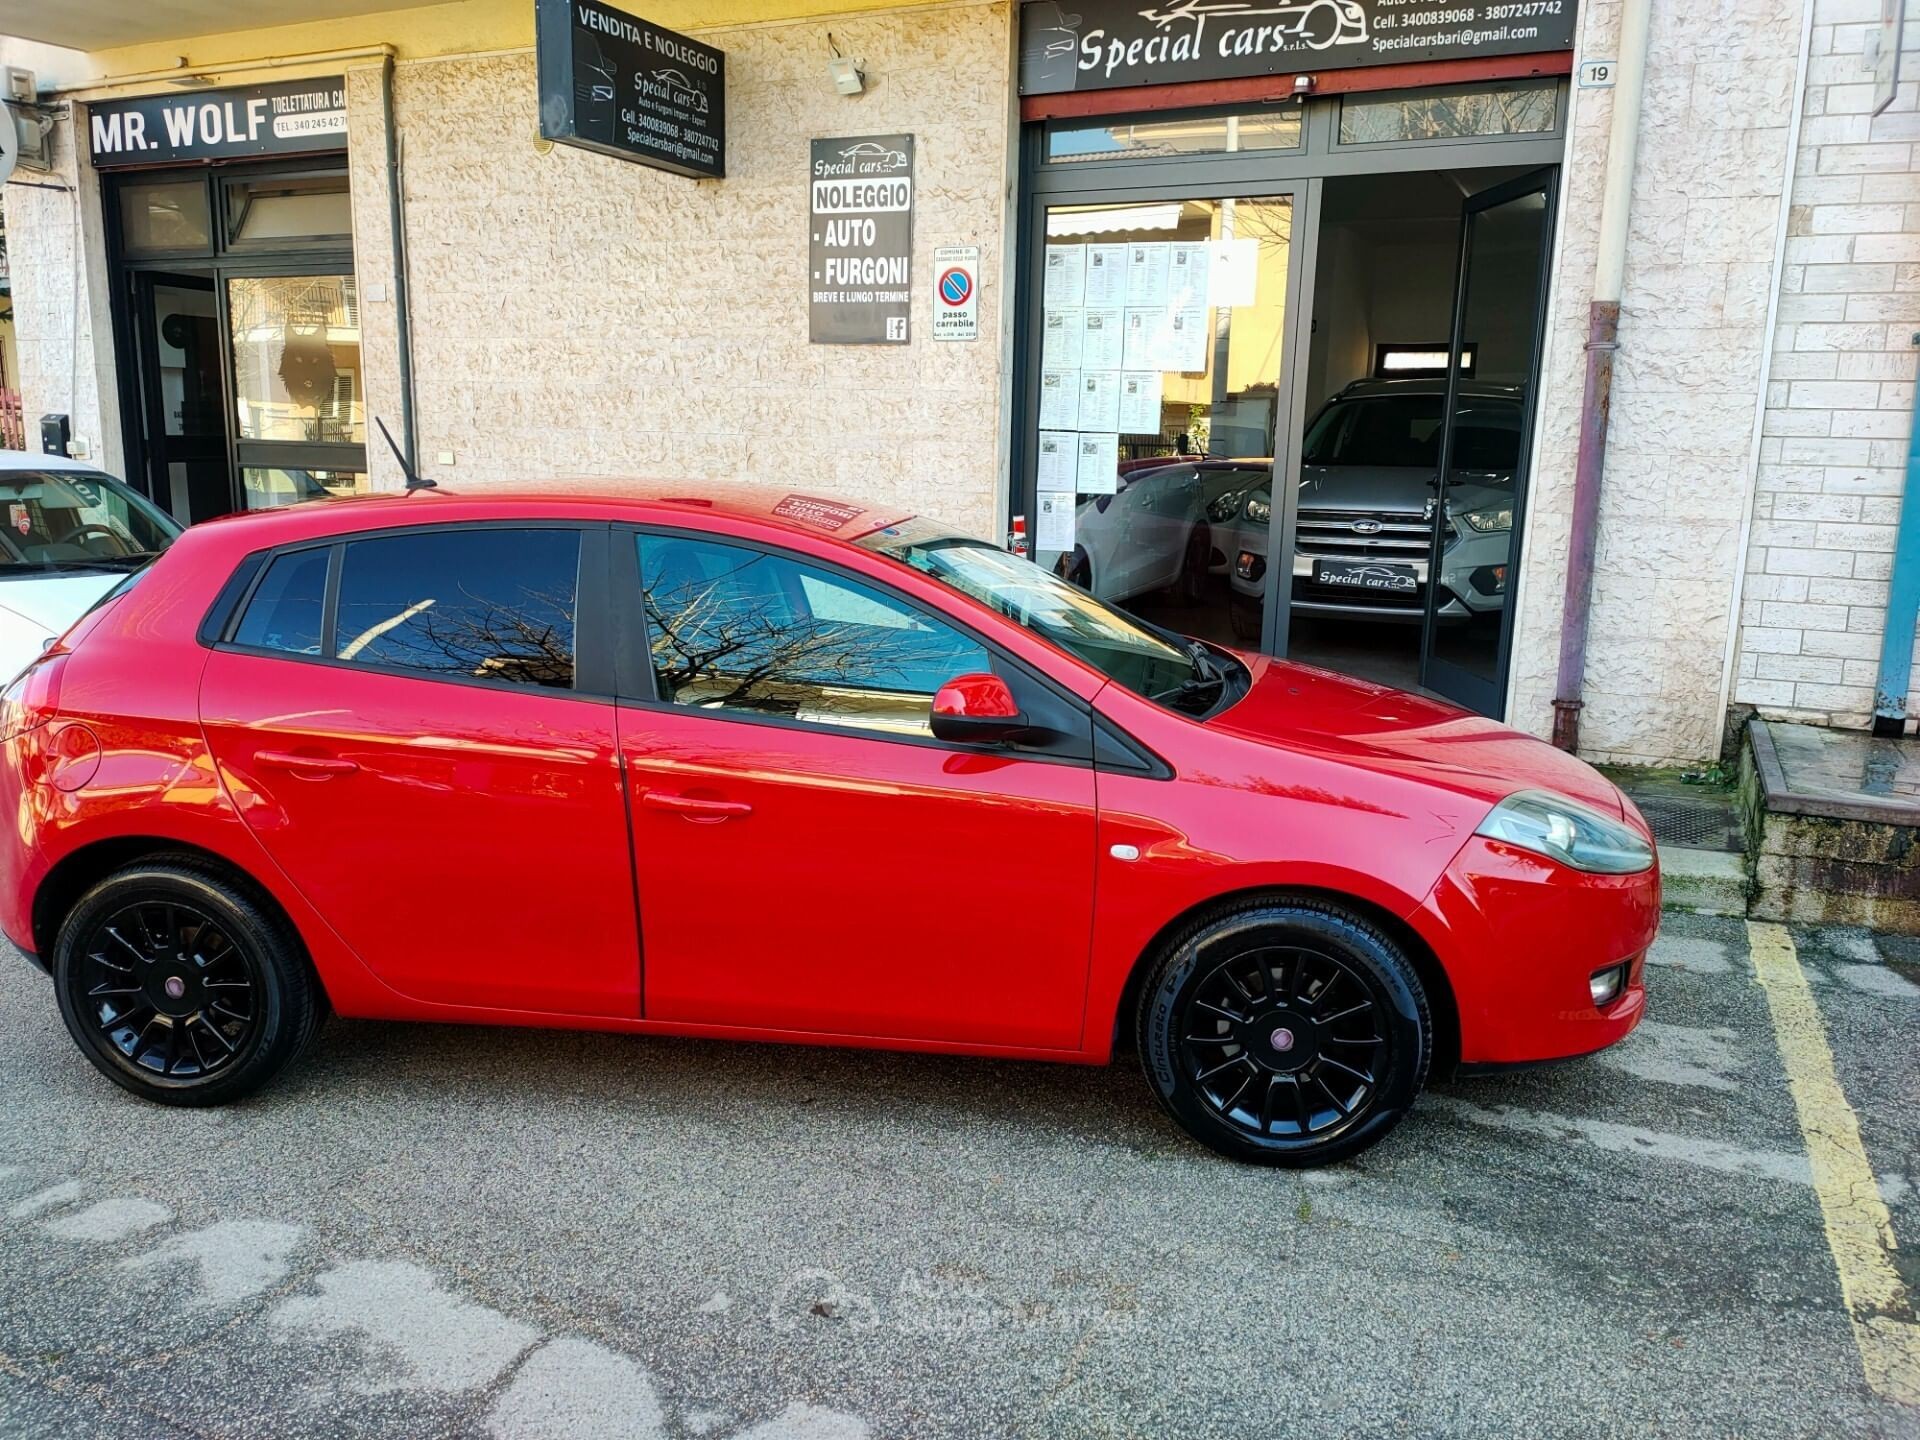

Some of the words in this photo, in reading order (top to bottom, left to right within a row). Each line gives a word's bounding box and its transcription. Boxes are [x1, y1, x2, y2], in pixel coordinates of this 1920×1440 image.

[1373, 14, 1398, 29] Cell.
[1401, 8, 1474, 27] 3400839068
[1486, 1, 1561, 20] 3807247742
[579, 5, 641, 45] VENDITA
[645, 31, 652, 49] E
[656, 36, 717, 75] NOLEGGIO
[1078, 14, 1205, 78] Special
[1219, 24, 1286, 58] cars
[1372, 25, 1538, 51] Specialcarsbari@gmail.com
[1591, 67, 1609, 81] 19
[271, 91, 330, 114] TOELETTATURA
[634, 72, 670, 100] Special
[673, 91, 690, 107] cars
[92, 112, 158, 154] MR.
[163, 98, 267, 148] WOLF
[275, 121, 293, 133] TEL.
[294, 119, 310, 130] 340
[311, 118, 327, 129] 245
[328, 117, 339, 127] 42
[621, 108, 637, 125] Cell.
[638, 113, 679, 138] 3400839068
[627, 127, 714, 165] Specialcarsbari@gmail.com
[814, 156, 856, 179] Special
[859, 161, 882, 173] cars
[816, 183, 908, 209] NOLEGGIO
[824, 218, 876, 247] AUTO
[825, 257, 908, 285] FURGONI
[813, 291, 838, 303] BREVE
[839, 291, 845, 303] E
[846, 291, 873, 303] LUNGO
[875, 291, 909, 303] TERMINE
[936, 319, 974, 328] carrabile
[942, 312, 968, 320] passo
[1320, 571, 1362, 585] Special
[1366, 577, 1390, 588] cars
